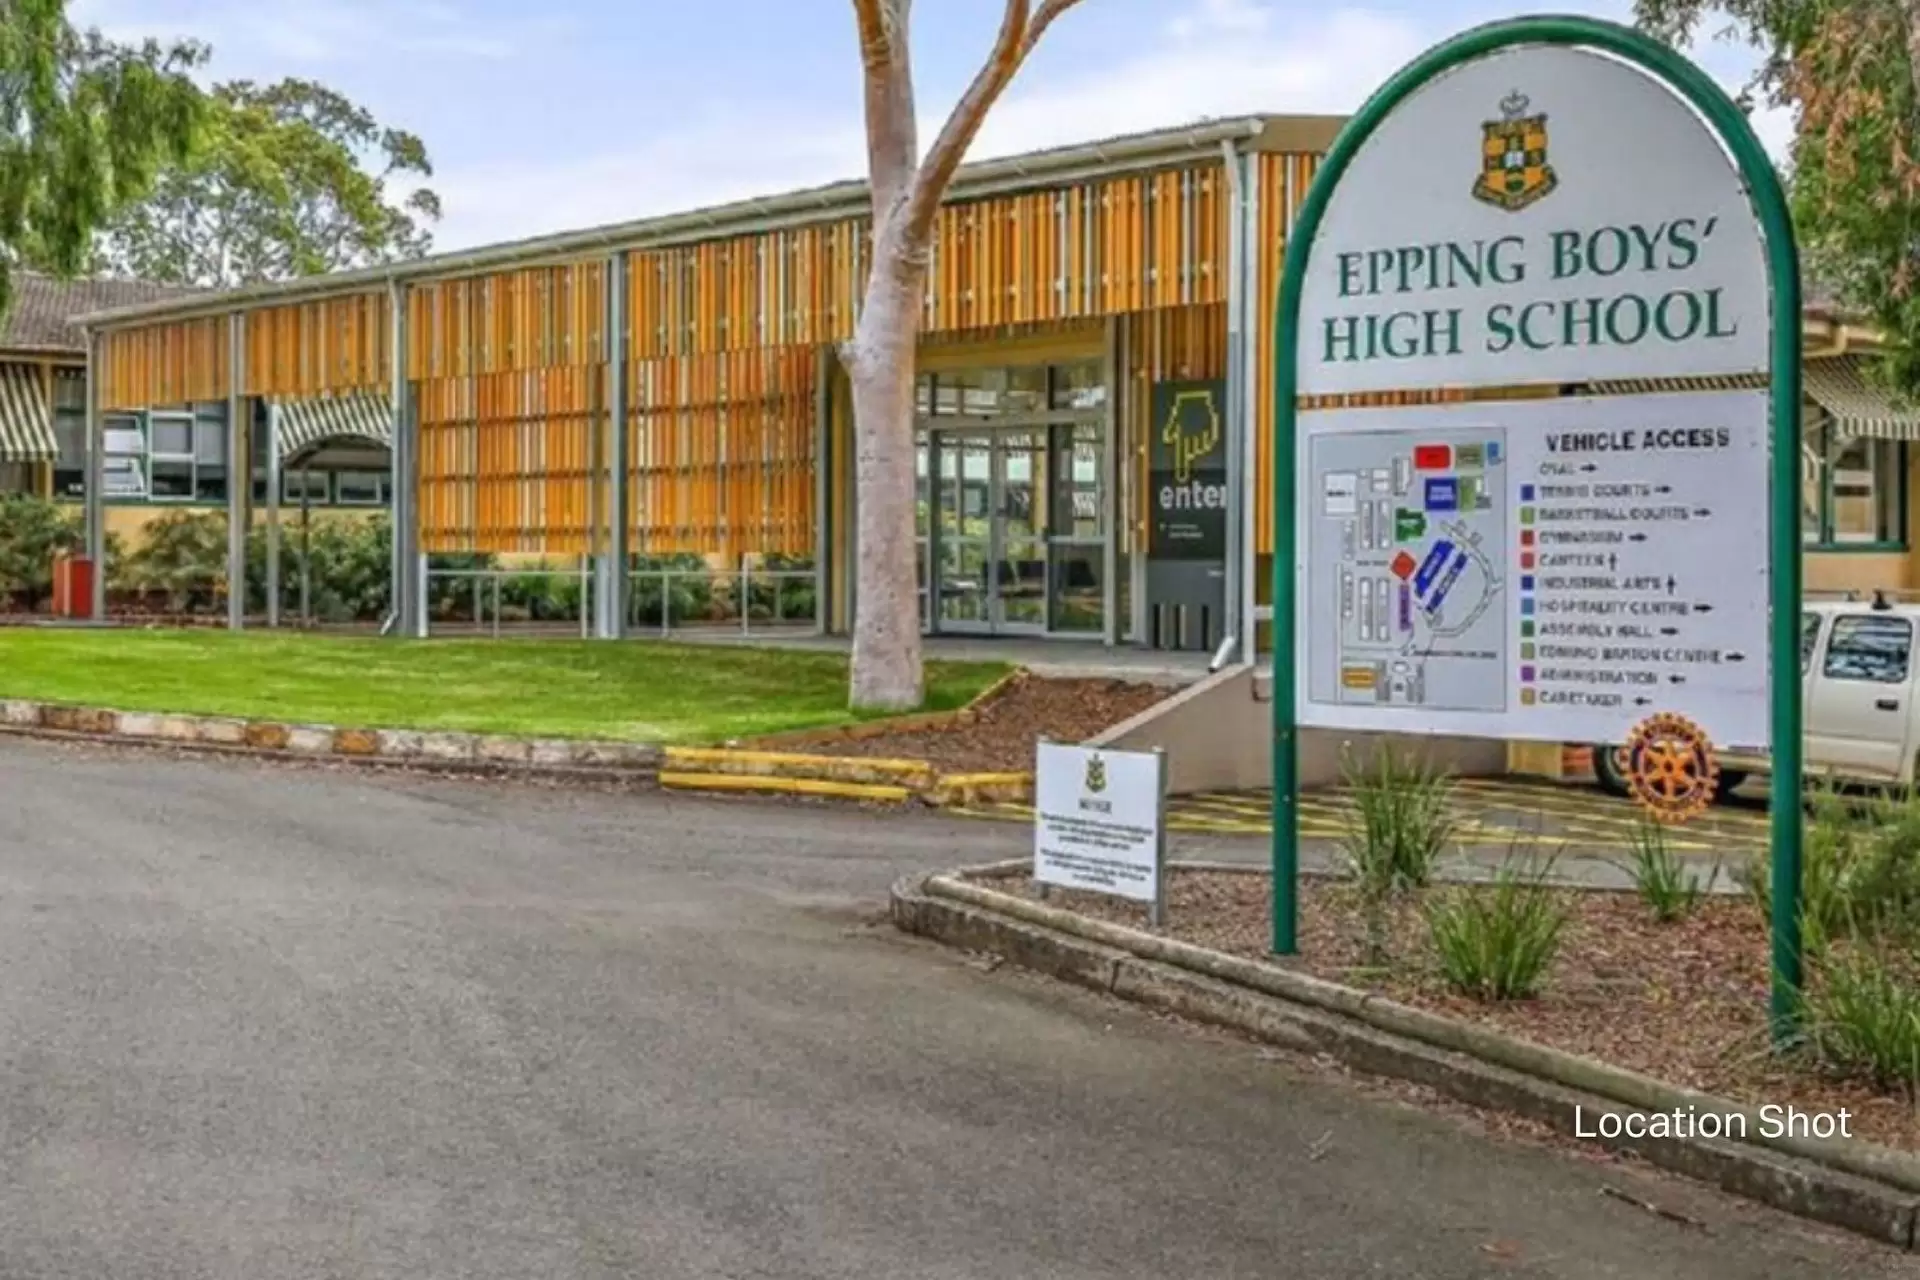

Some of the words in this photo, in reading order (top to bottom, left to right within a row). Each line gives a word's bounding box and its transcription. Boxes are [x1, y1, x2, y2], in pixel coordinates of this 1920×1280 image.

[1337, 236, 1525, 298] EPPING
[1322, 309, 1464, 362] HIGH
[1486, 287, 1738, 353] SCHOOL
[1546, 430, 1636, 452] VEHICLE
[1643, 427, 1730, 449] ACCESS
